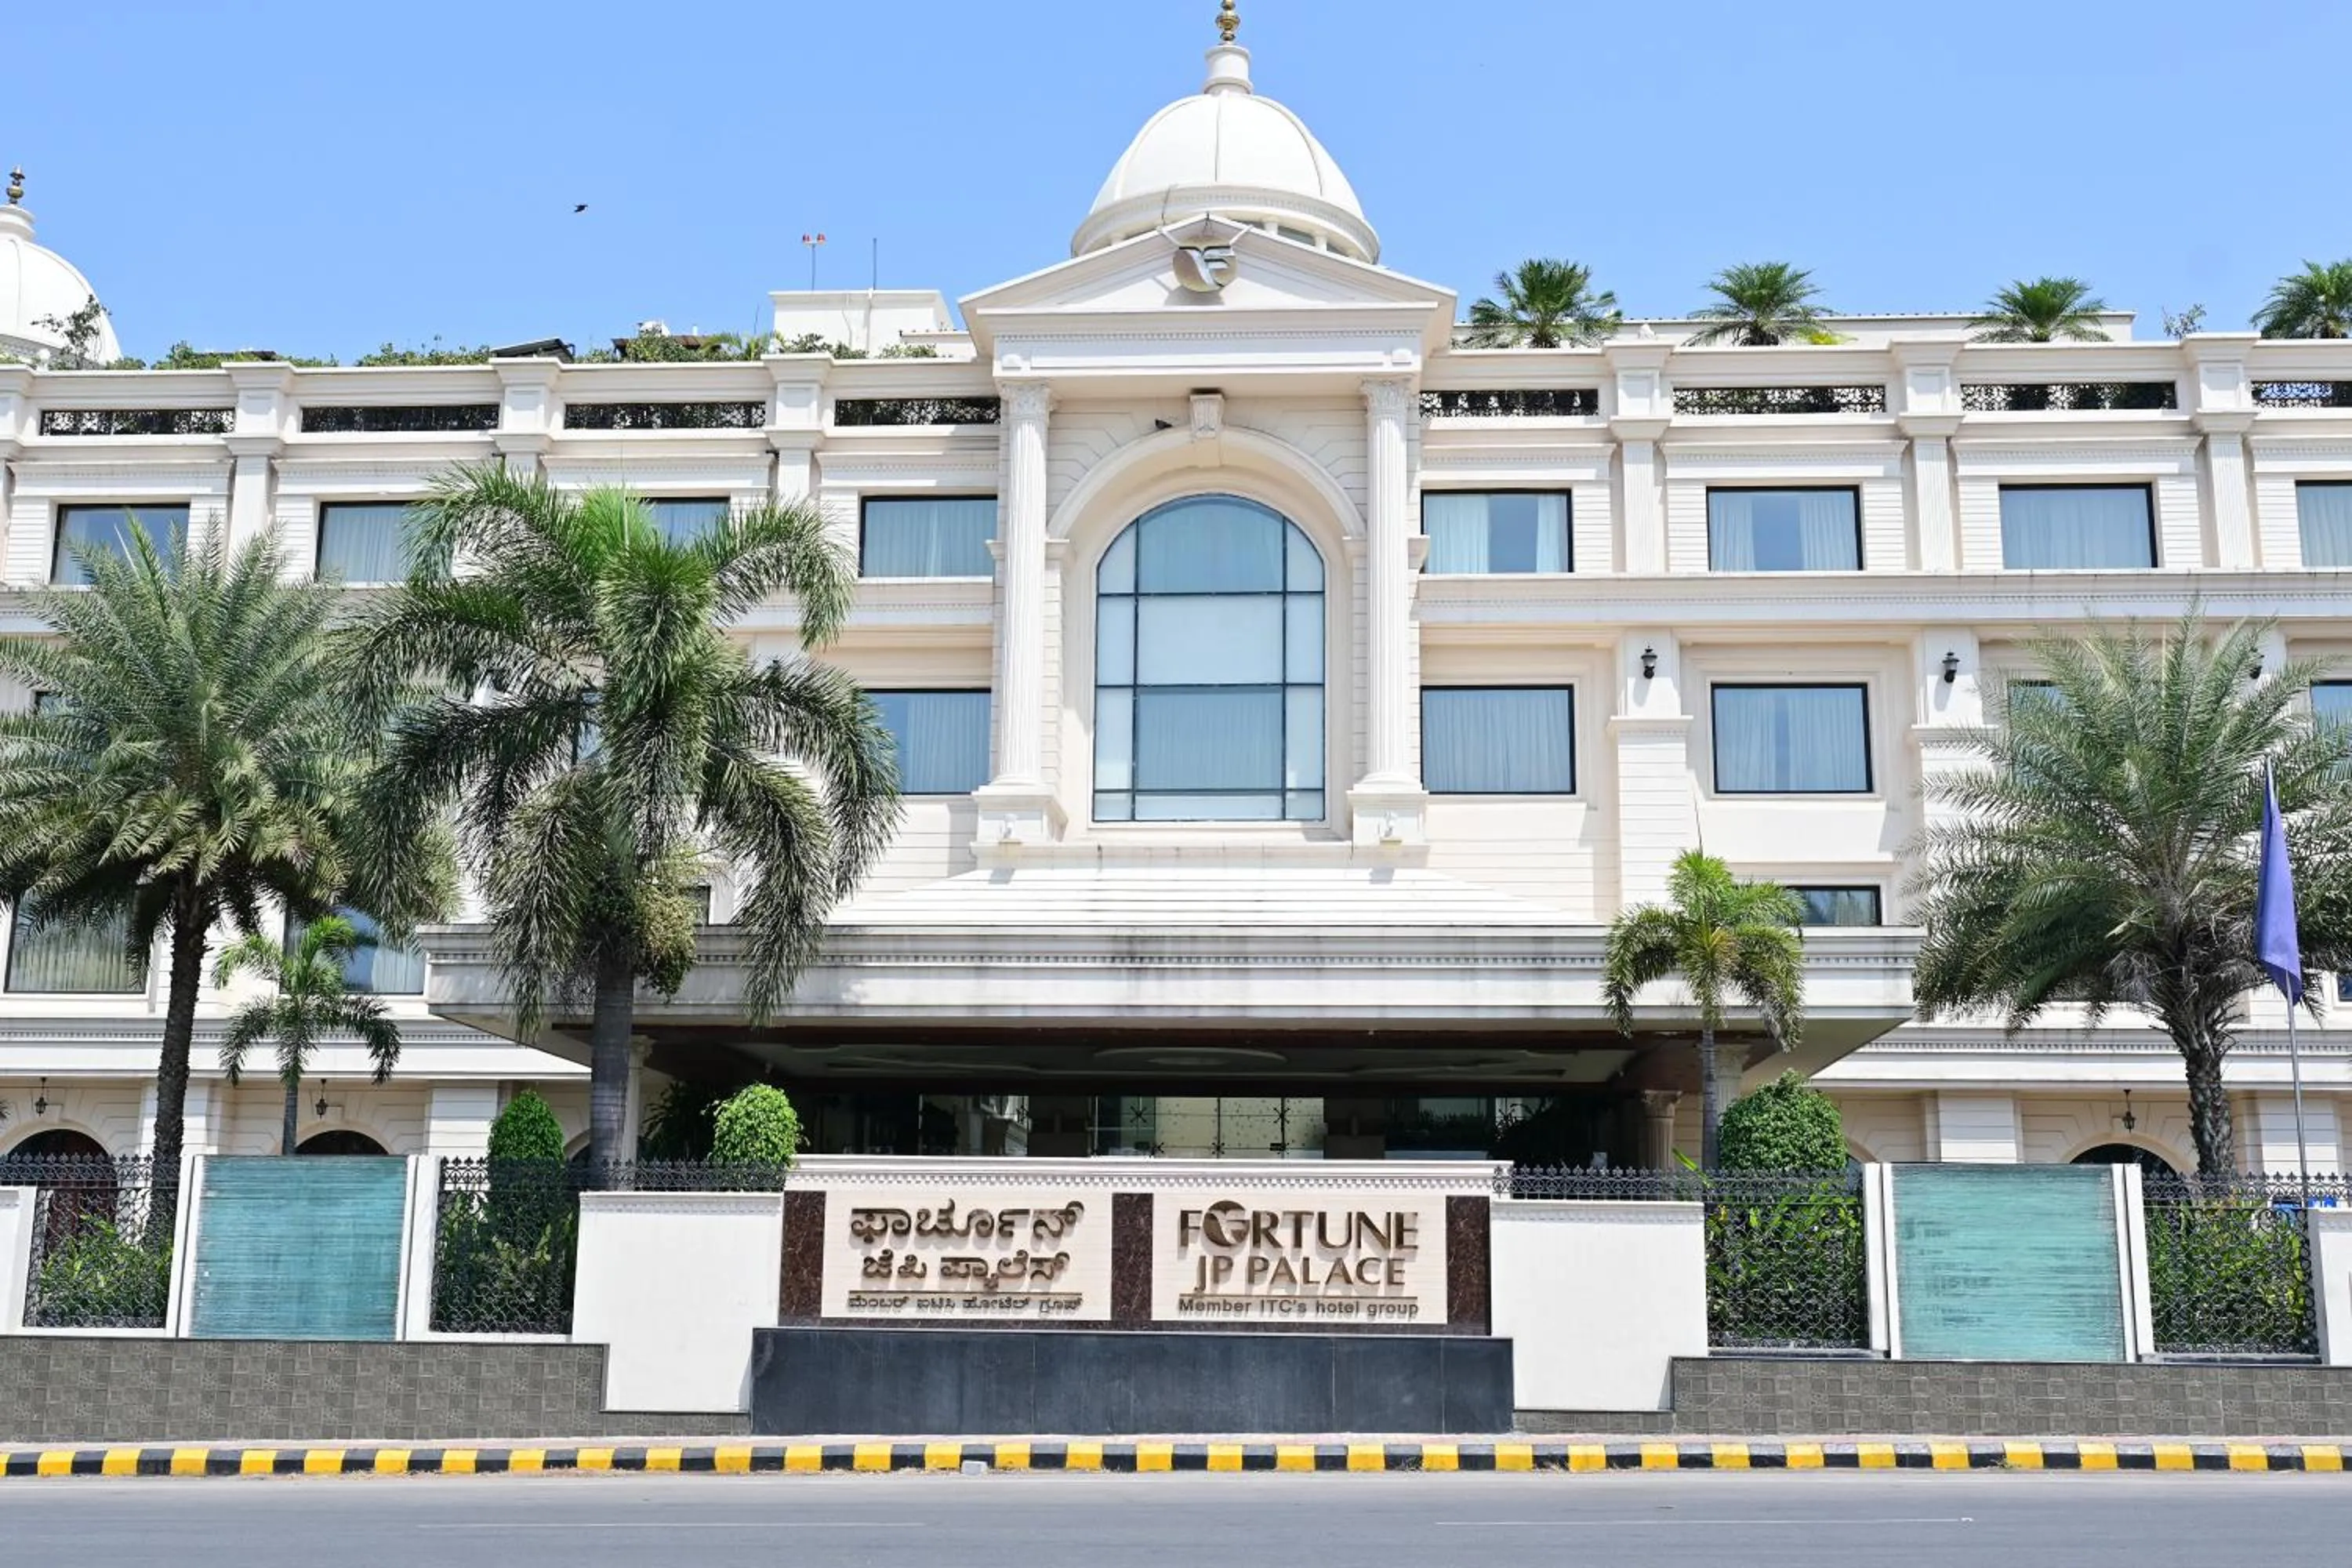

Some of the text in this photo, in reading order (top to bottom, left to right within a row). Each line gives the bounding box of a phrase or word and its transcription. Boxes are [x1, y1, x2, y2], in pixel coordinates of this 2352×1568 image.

[1179, 1200, 1418, 1250] FORTUNE
[1193, 1255, 1406, 1292] JP PALACE
[1179, 1298, 1418, 1318] Member ITC's hotel group
